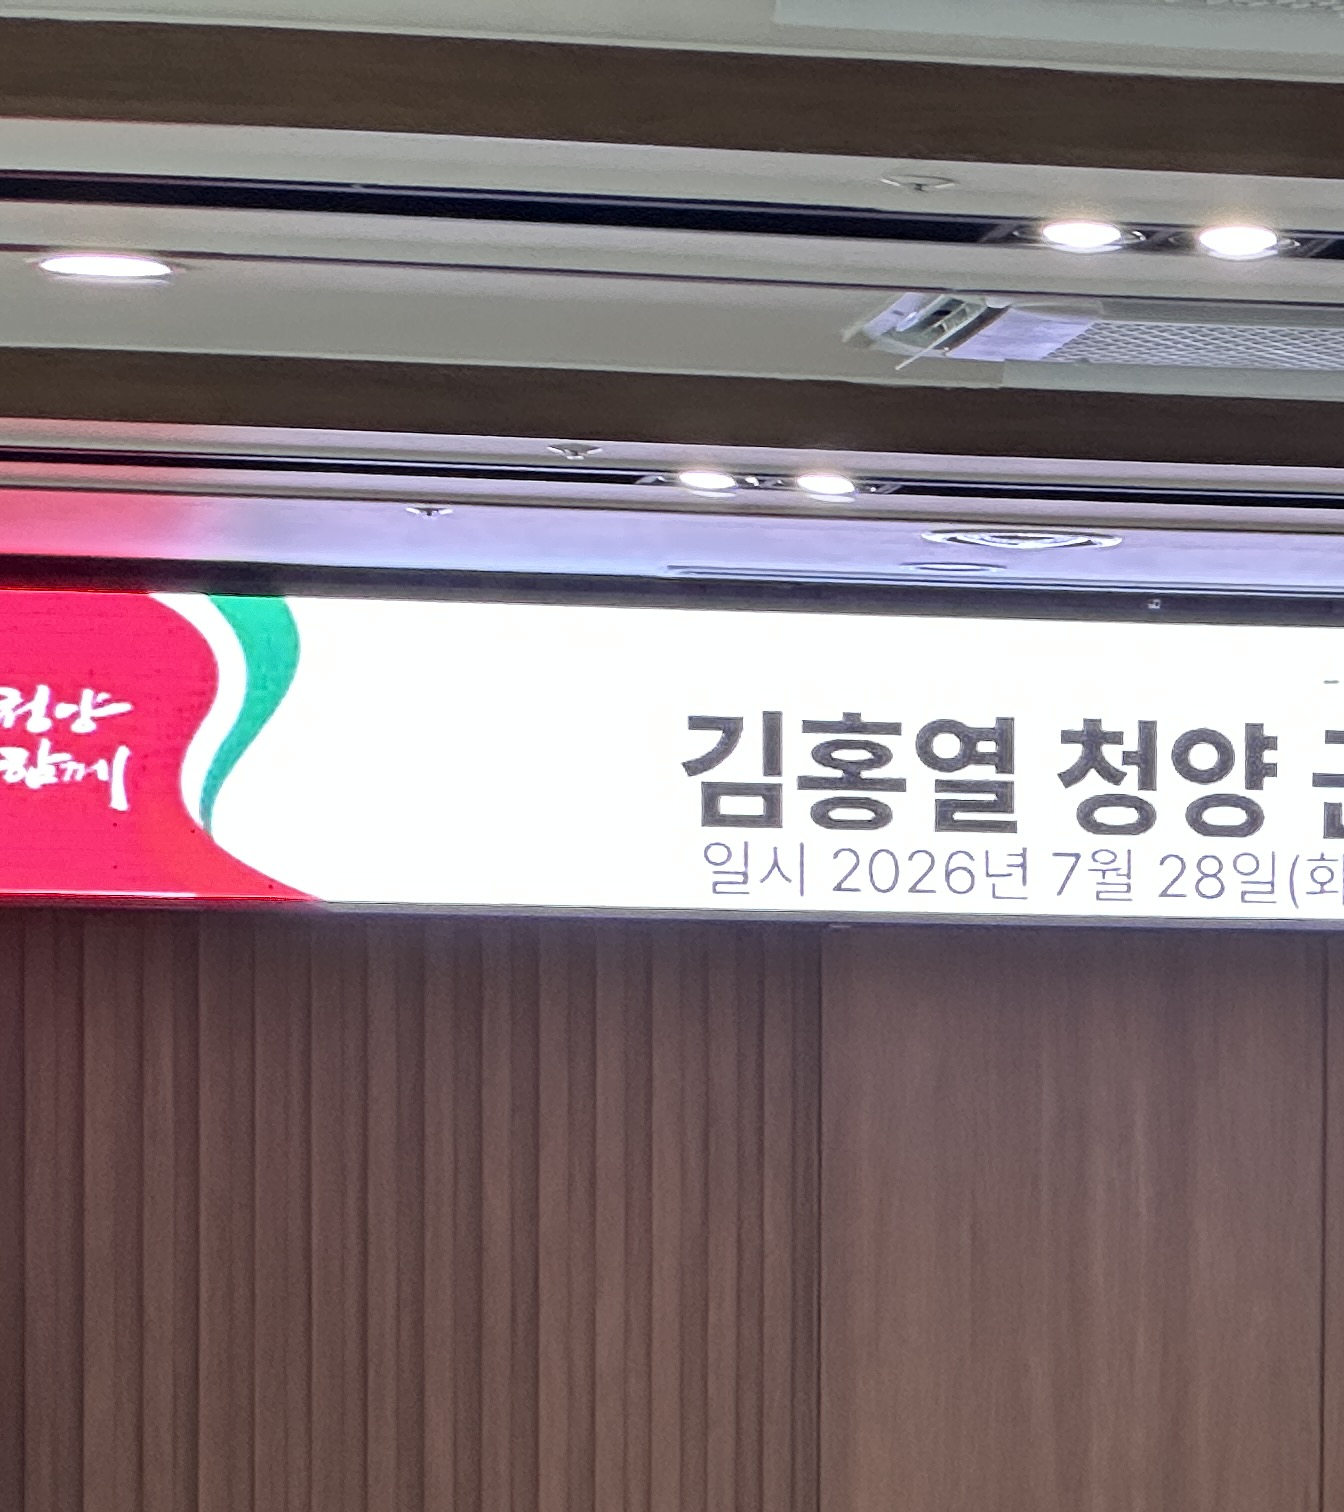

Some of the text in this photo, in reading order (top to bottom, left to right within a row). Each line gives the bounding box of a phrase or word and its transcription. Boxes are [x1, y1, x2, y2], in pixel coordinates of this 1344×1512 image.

[680, 710, 1018, 834] 김홍열
[1056, 717, 1279, 839] 청양
[703, 840, 805, 897] 일시
[832, 847, 1028, 900] 2026년
[1051, 848, 1133, 902] 7월
